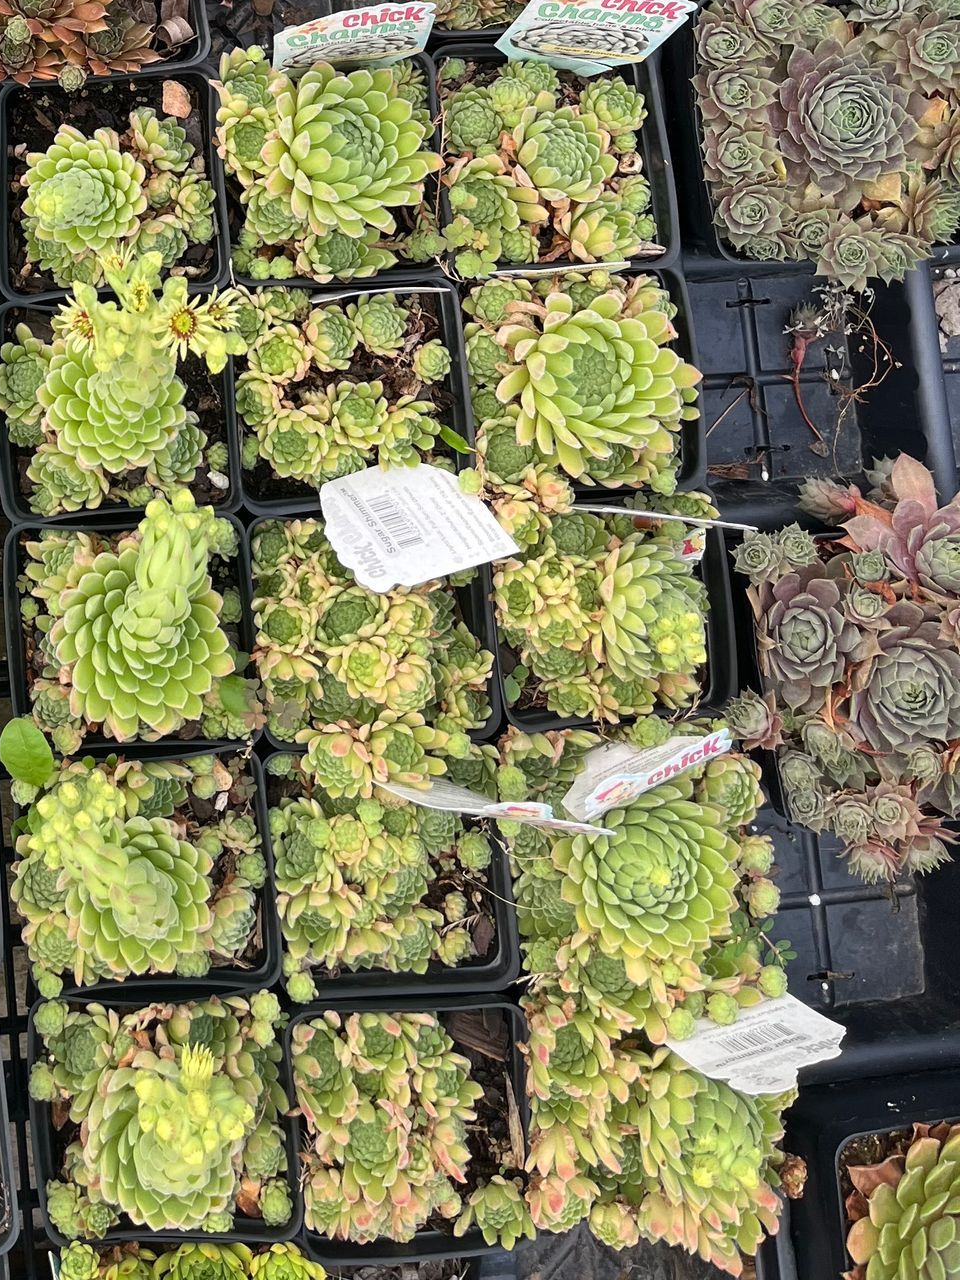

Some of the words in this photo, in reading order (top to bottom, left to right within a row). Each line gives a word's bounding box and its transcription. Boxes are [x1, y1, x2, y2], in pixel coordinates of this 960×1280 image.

[342, 6, 426, 28] Chick
[375, 528, 397, 554] Sugar
[352, 540, 387, 579] Chick
[647, 736, 723, 786] Chick
[774, 1035, 807, 1048] Sugar
